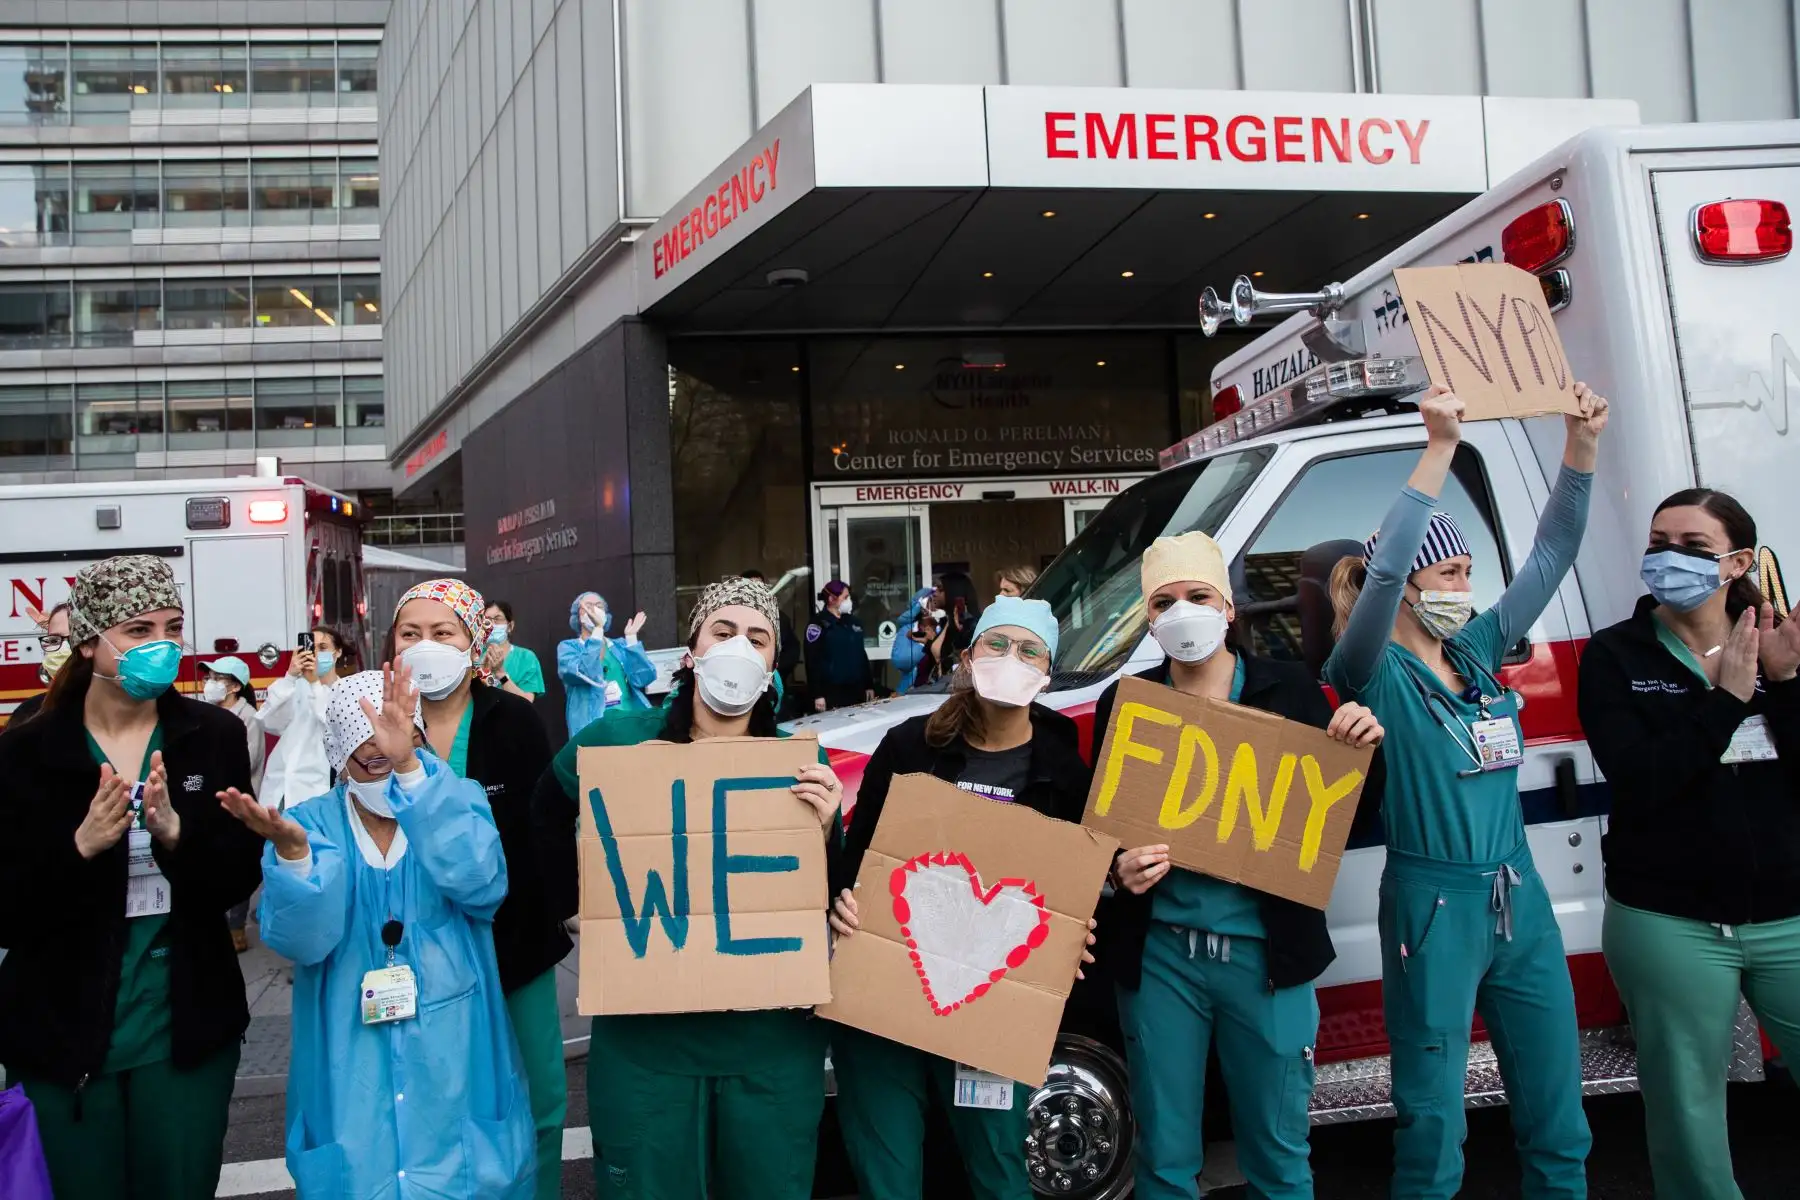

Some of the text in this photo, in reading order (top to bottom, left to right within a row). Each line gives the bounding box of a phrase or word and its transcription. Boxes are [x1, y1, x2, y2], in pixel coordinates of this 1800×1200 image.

[1045, 111, 1431, 165] EMERGENCY
[652, 137, 781, 281] EMERGENCY
[1415, 292, 1566, 395] NYPD
[1252, 348, 1323, 400] HATZALA
[888, 424, 1102, 444] RONALD O. PERELMAN
[833, 444, 1155, 471] Center for Emergency Services
[856, 479, 1120, 501] EMERGENCY WALK-IN
[1180, 640, 1195, 649] 3M
[723, 679, 738, 689] 3M
[957, 781, 1015, 798] FOR NEW YORK.
[1094, 701, 1365, 874] FDNY
[588, 776, 803, 960] WE
